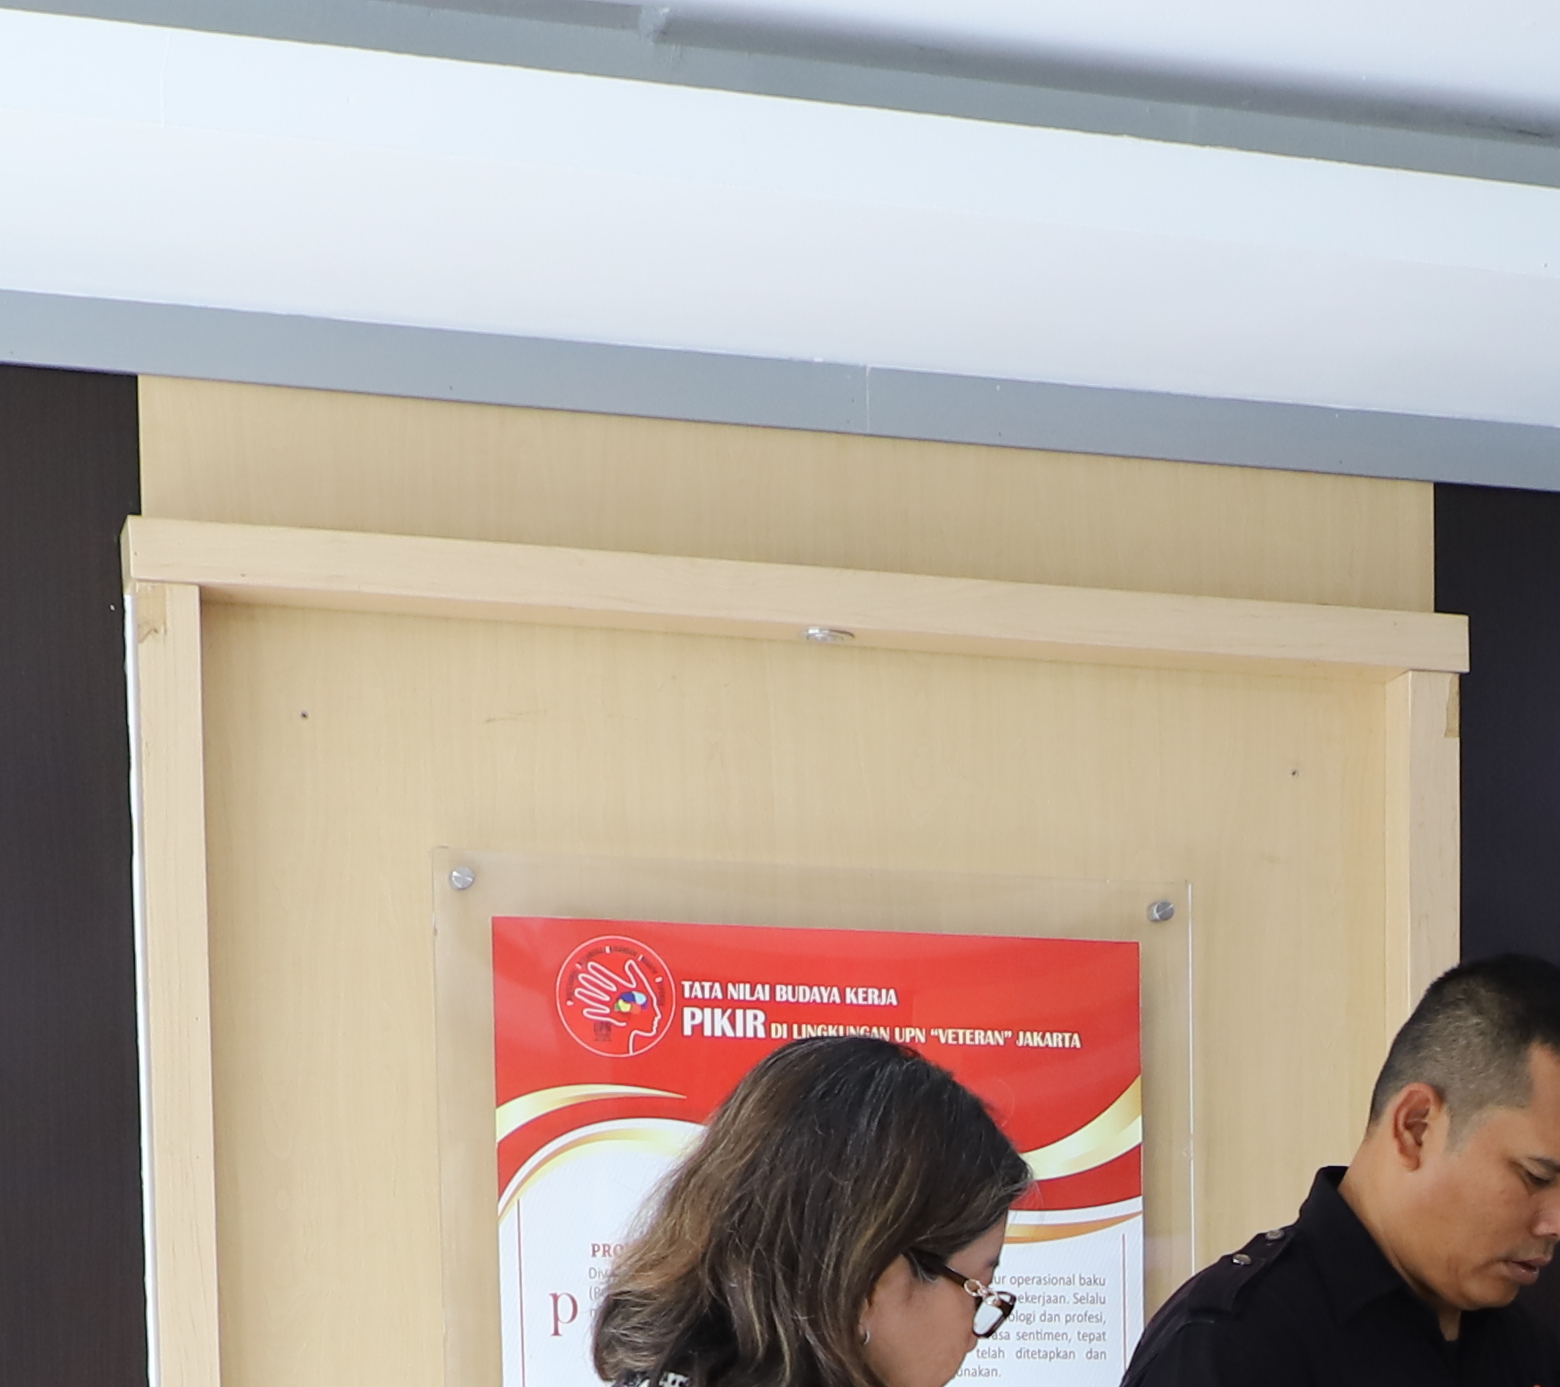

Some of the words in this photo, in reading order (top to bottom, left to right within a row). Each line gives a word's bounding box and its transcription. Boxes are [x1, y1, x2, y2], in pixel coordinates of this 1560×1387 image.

[681, 980, 723, 1000] TATA
[727, 982, 771, 1002] NILAI
[775, 984, 841, 1004] BUDAYA
[844, 987, 898, 1006] KERJA
[682, 1006, 767, 1039] PIKIR
[770, 1023, 788, 1040] DI
[894, 1028, 926, 1044] UPN
[1015, 1031, 1082, 1049] JAKARTA
[1009, 1273, 1076, 1288] operasional
[1072, 1292, 1107, 1305] Selalu
[1064, 1310, 1107, 1326] profesi,
[1015, 1329, 1072, 1343] sentimen,
[1077, 1330, 1107, 1344] tepat
[976, 1347, 1006, 1359] telah
[1015, 1347, 1076, 1363] ditetapkan
